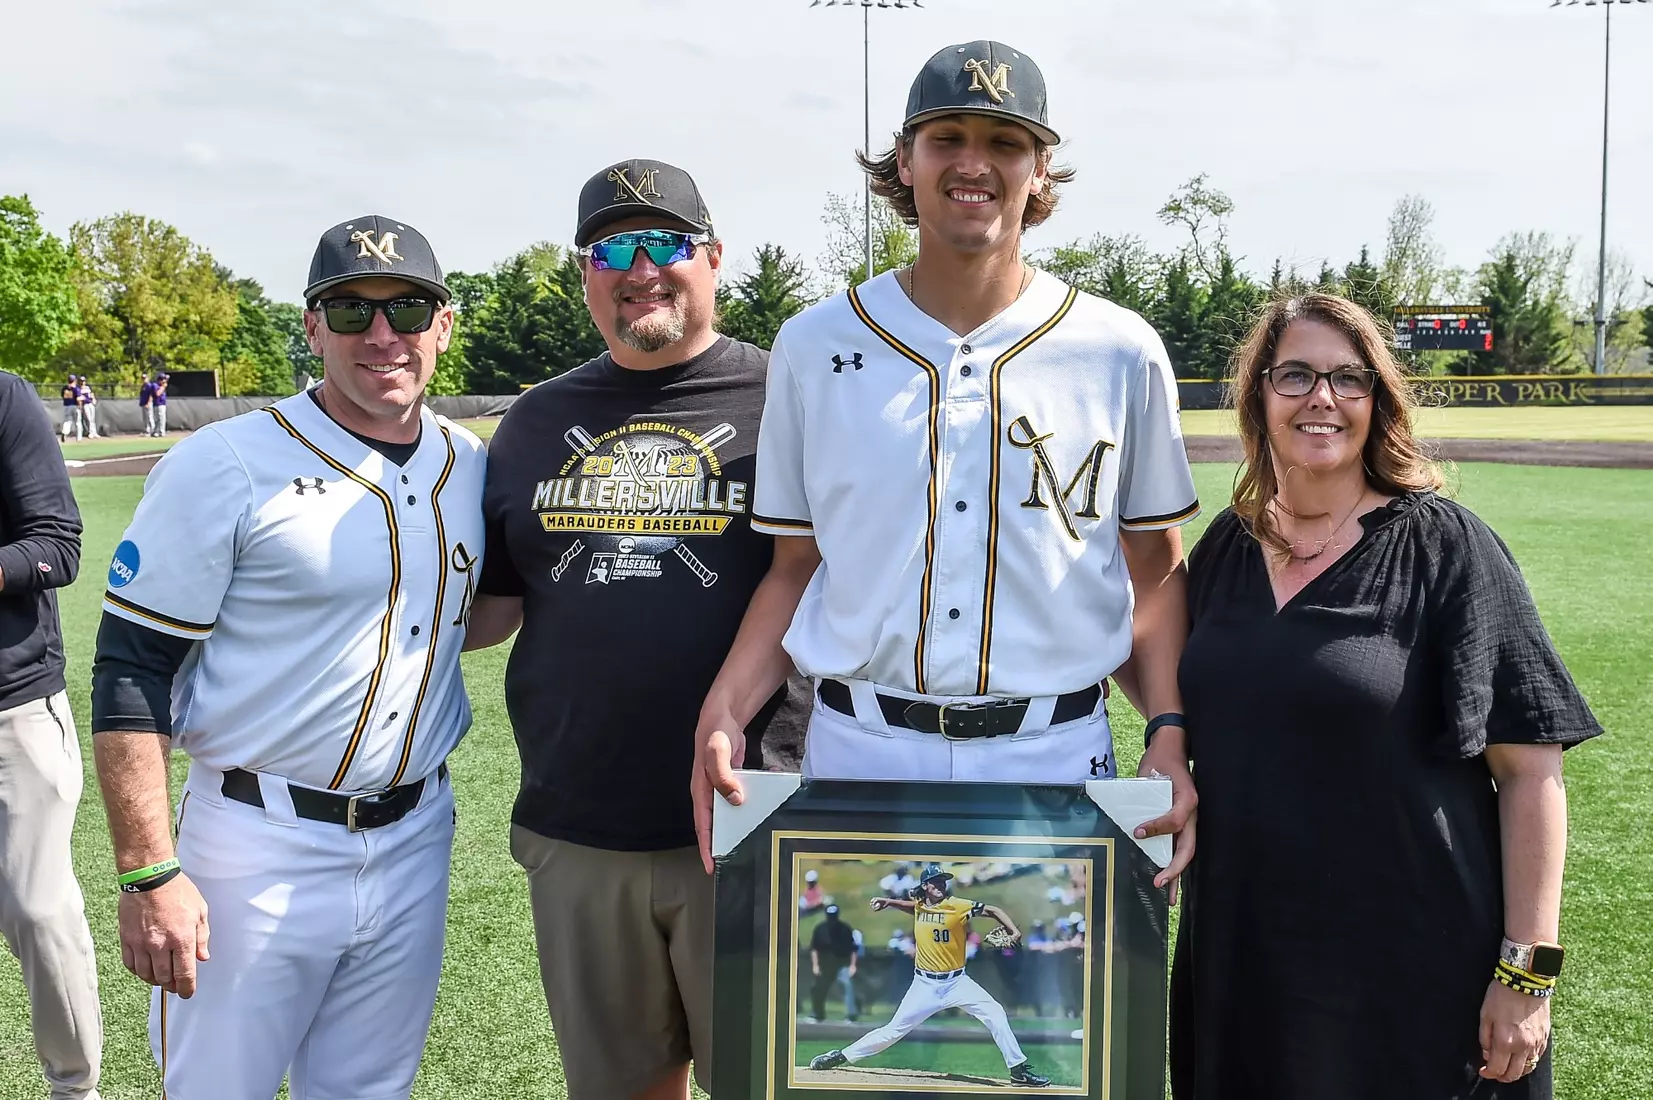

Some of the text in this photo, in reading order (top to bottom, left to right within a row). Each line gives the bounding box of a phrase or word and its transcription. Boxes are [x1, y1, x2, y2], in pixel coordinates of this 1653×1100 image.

[964, 58, 1015, 103] M
[608, 168, 664, 205] M
[351, 230, 404, 265] M
[1512, 382, 1595, 404] PARK
[559, 453, 580, 476] NCAA
[629, 423, 676, 434] BASEBALL
[581, 455, 615, 477] 20
[666, 455, 699, 477] 23
[1007, 415, 1115, 542] M
[531, 477, 748, 514] MILLERSVILLE
[547, 516, 719, 531] MARAUDERS BASEBALL
[111, 557, 134, 582] NCAA
[612, 569, 663, 577] CHAMPIONSHIP
[615, 559, 661, 570] BASEBALL
[123, 884, 140, 892] FCA
[932, 928, 950, 944] 30
